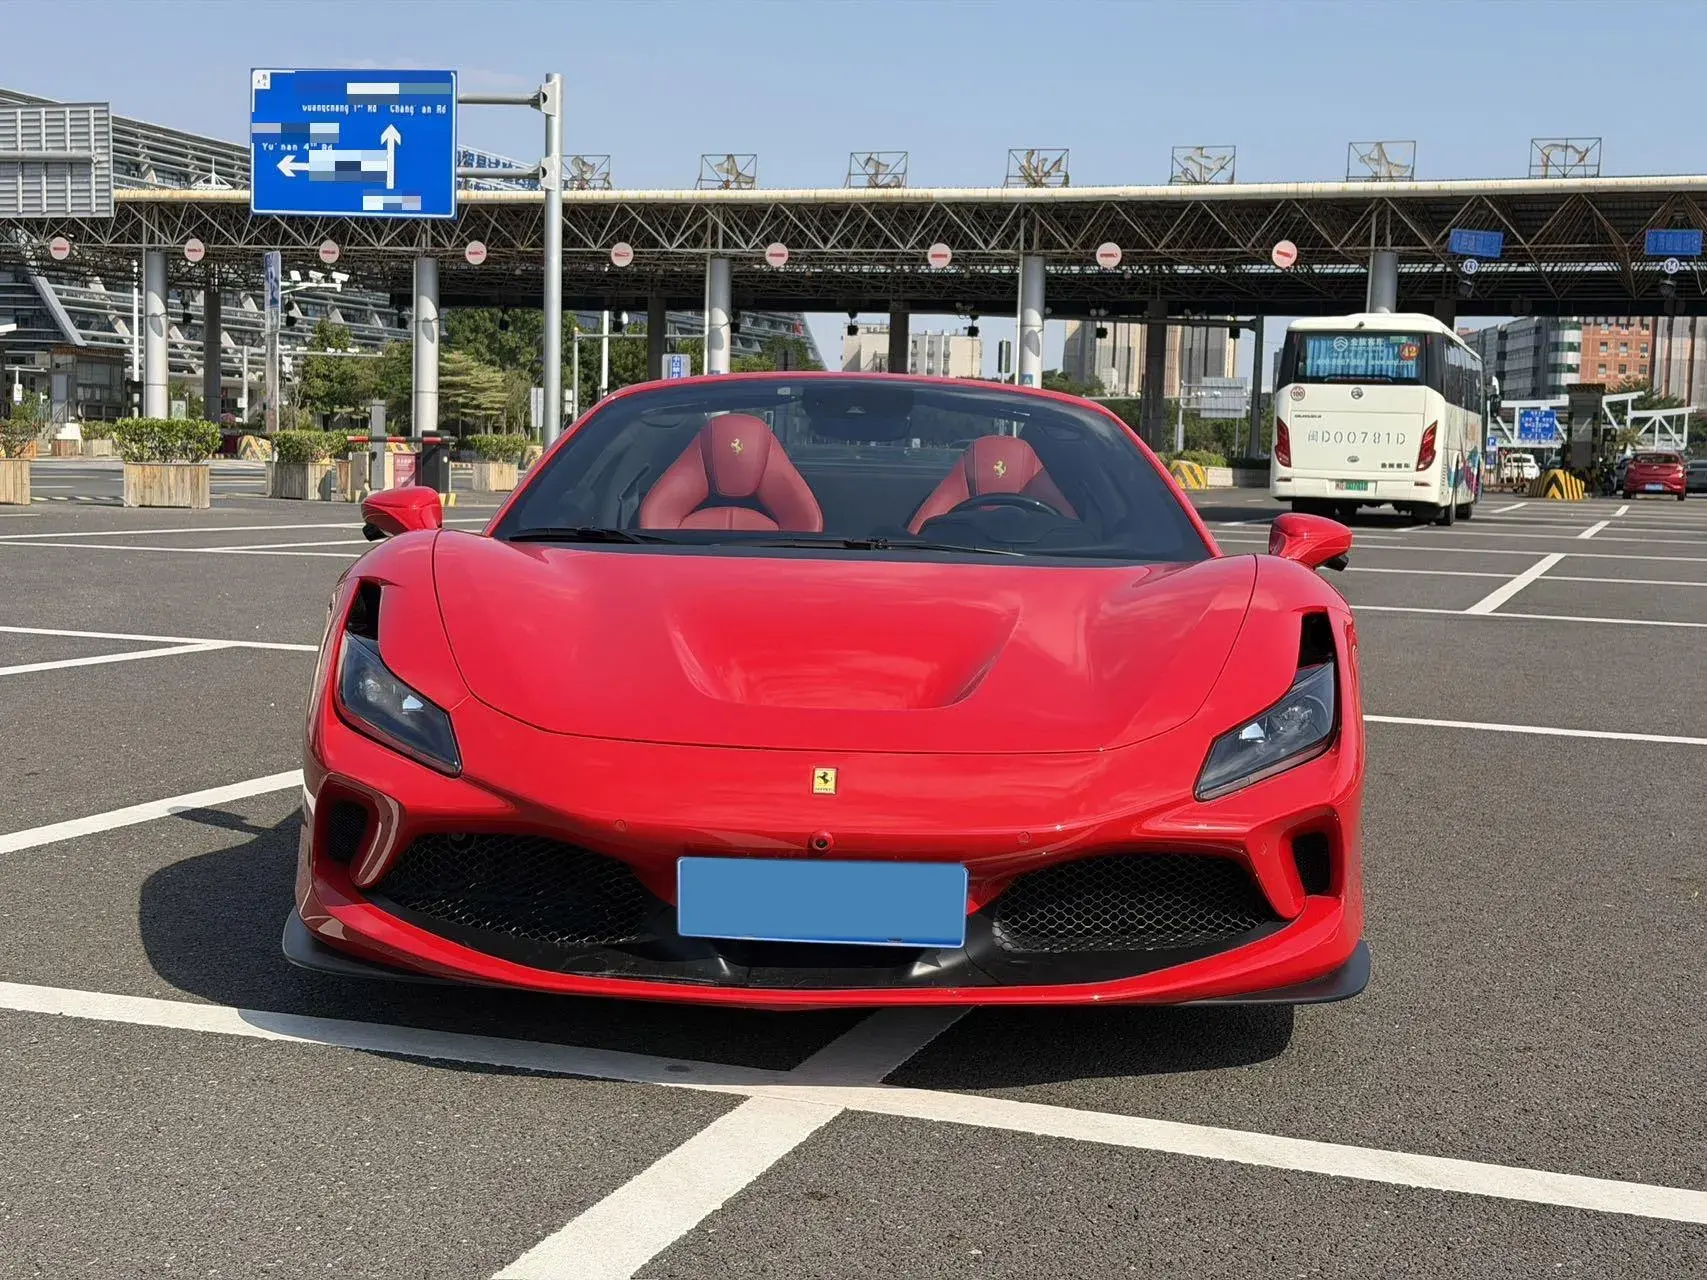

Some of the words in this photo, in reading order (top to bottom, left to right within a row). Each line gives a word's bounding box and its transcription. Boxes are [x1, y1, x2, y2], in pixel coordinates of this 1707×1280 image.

[280, 143, 298, 151] nan
[1403, 345, 1417, 357] 42
[1307, 430, 1406, 445] 闽D00781D
